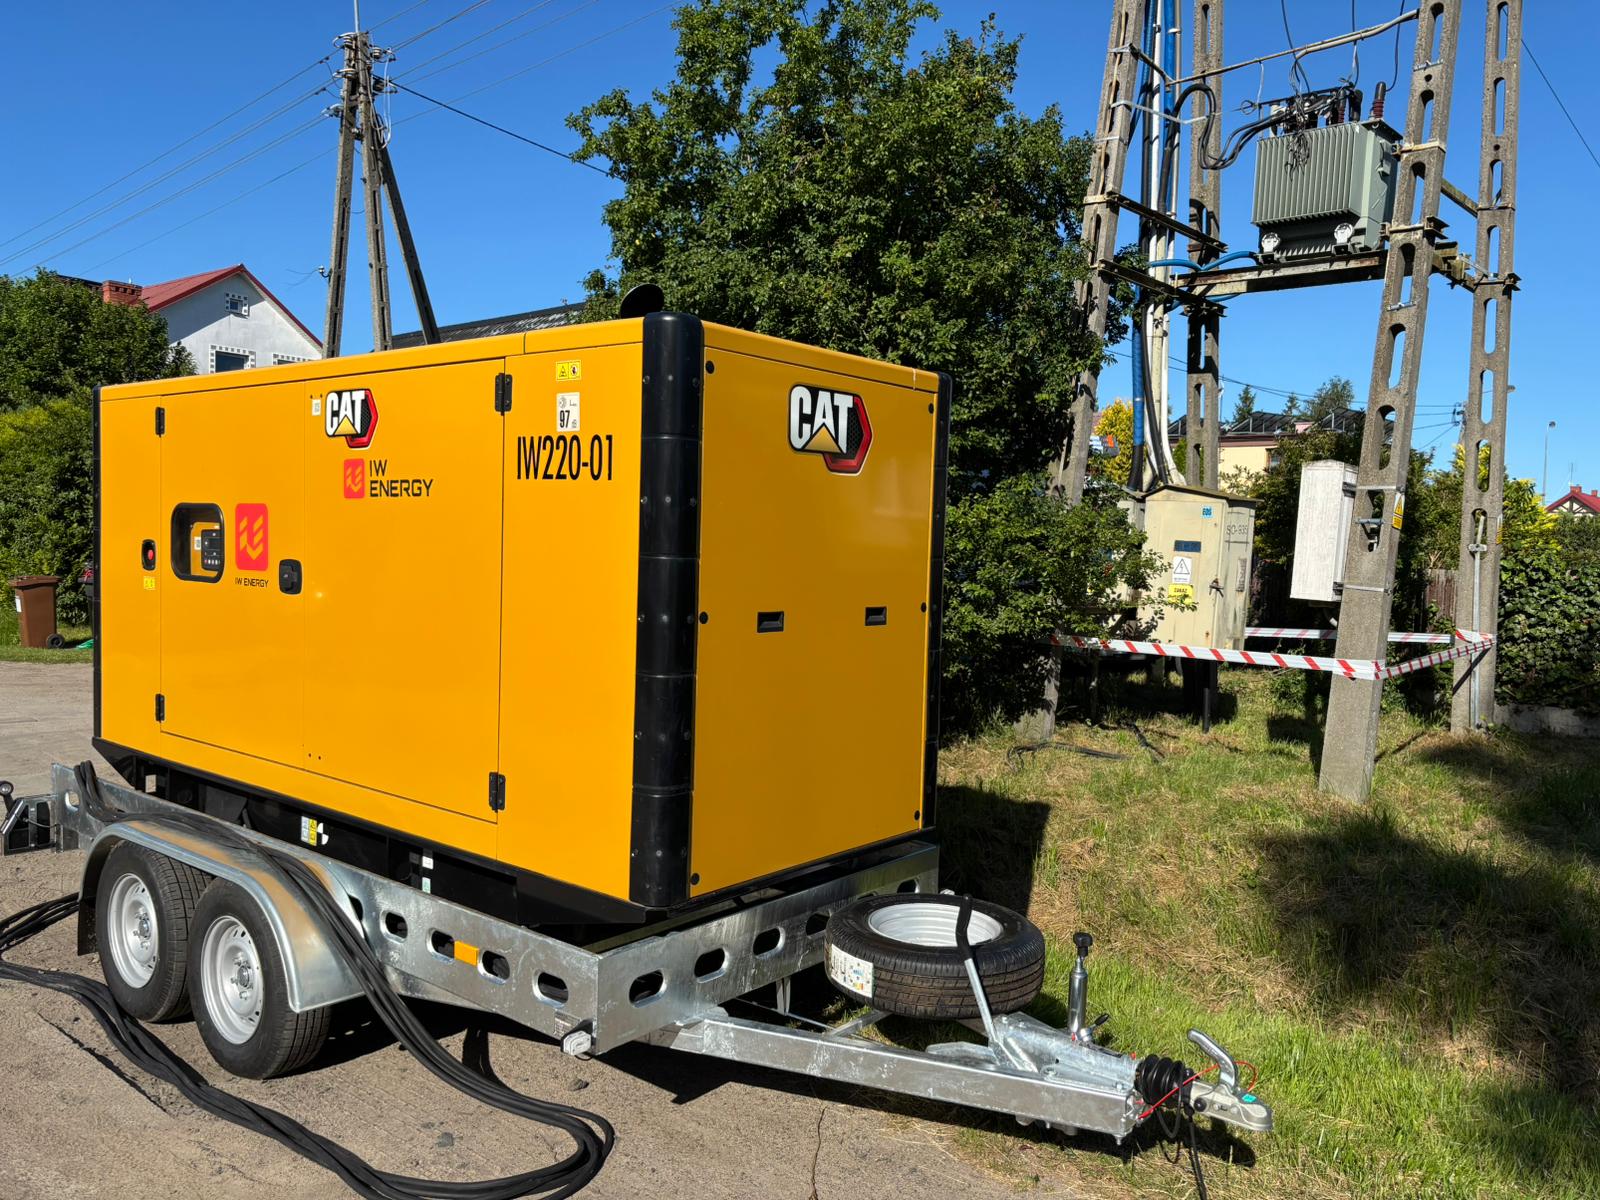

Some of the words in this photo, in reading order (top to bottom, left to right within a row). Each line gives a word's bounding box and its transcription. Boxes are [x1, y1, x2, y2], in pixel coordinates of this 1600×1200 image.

[326, 390, 366, 436] CAT
[559, 410, 570, 428] 97
[790, 386, 853, 453] CAT
[517, 434, 613, 480] IW220-01
[369, 459, 388, 477] IW
[369, 479, 433, 497] ENERGY
[235, 577, 242, 585] IW
[243, 578, 269, 588] ENERGY
